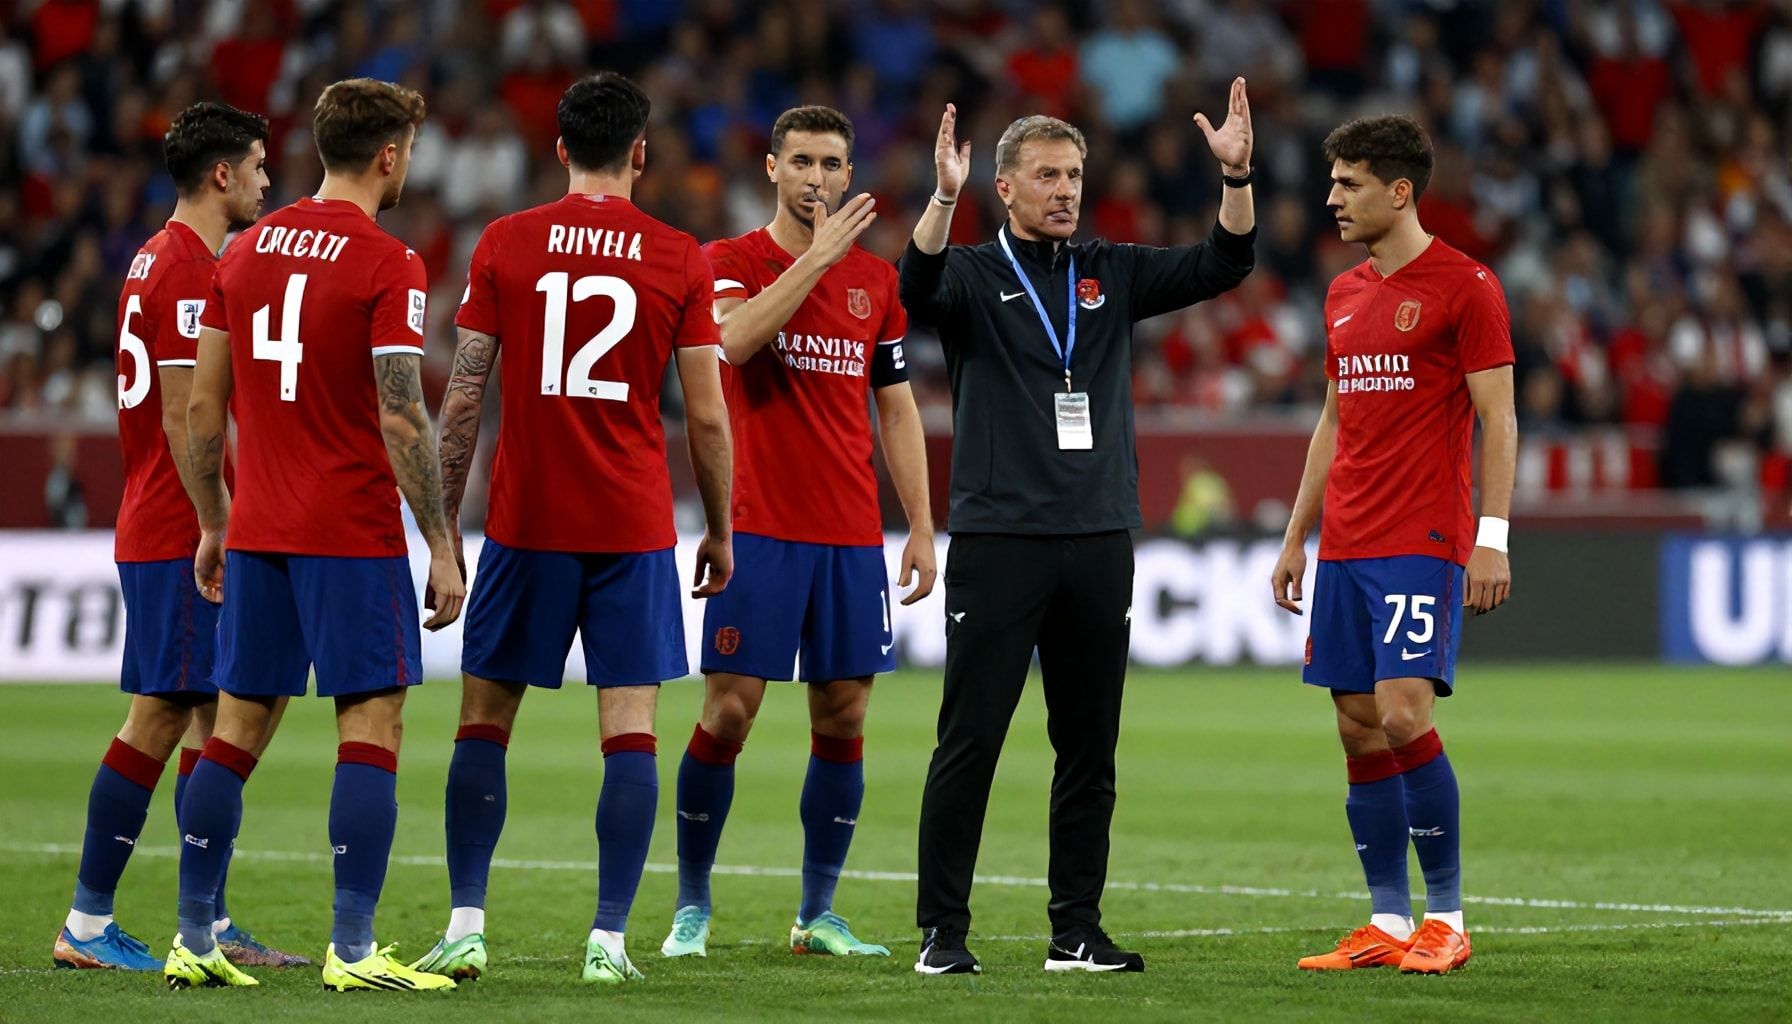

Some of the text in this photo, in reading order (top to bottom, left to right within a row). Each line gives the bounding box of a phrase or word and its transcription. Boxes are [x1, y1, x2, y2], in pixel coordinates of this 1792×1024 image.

[253, 274, 303, 402] 4
[536, 272, 637, 402] 12
[1383, 594, 1436, 644] 75
